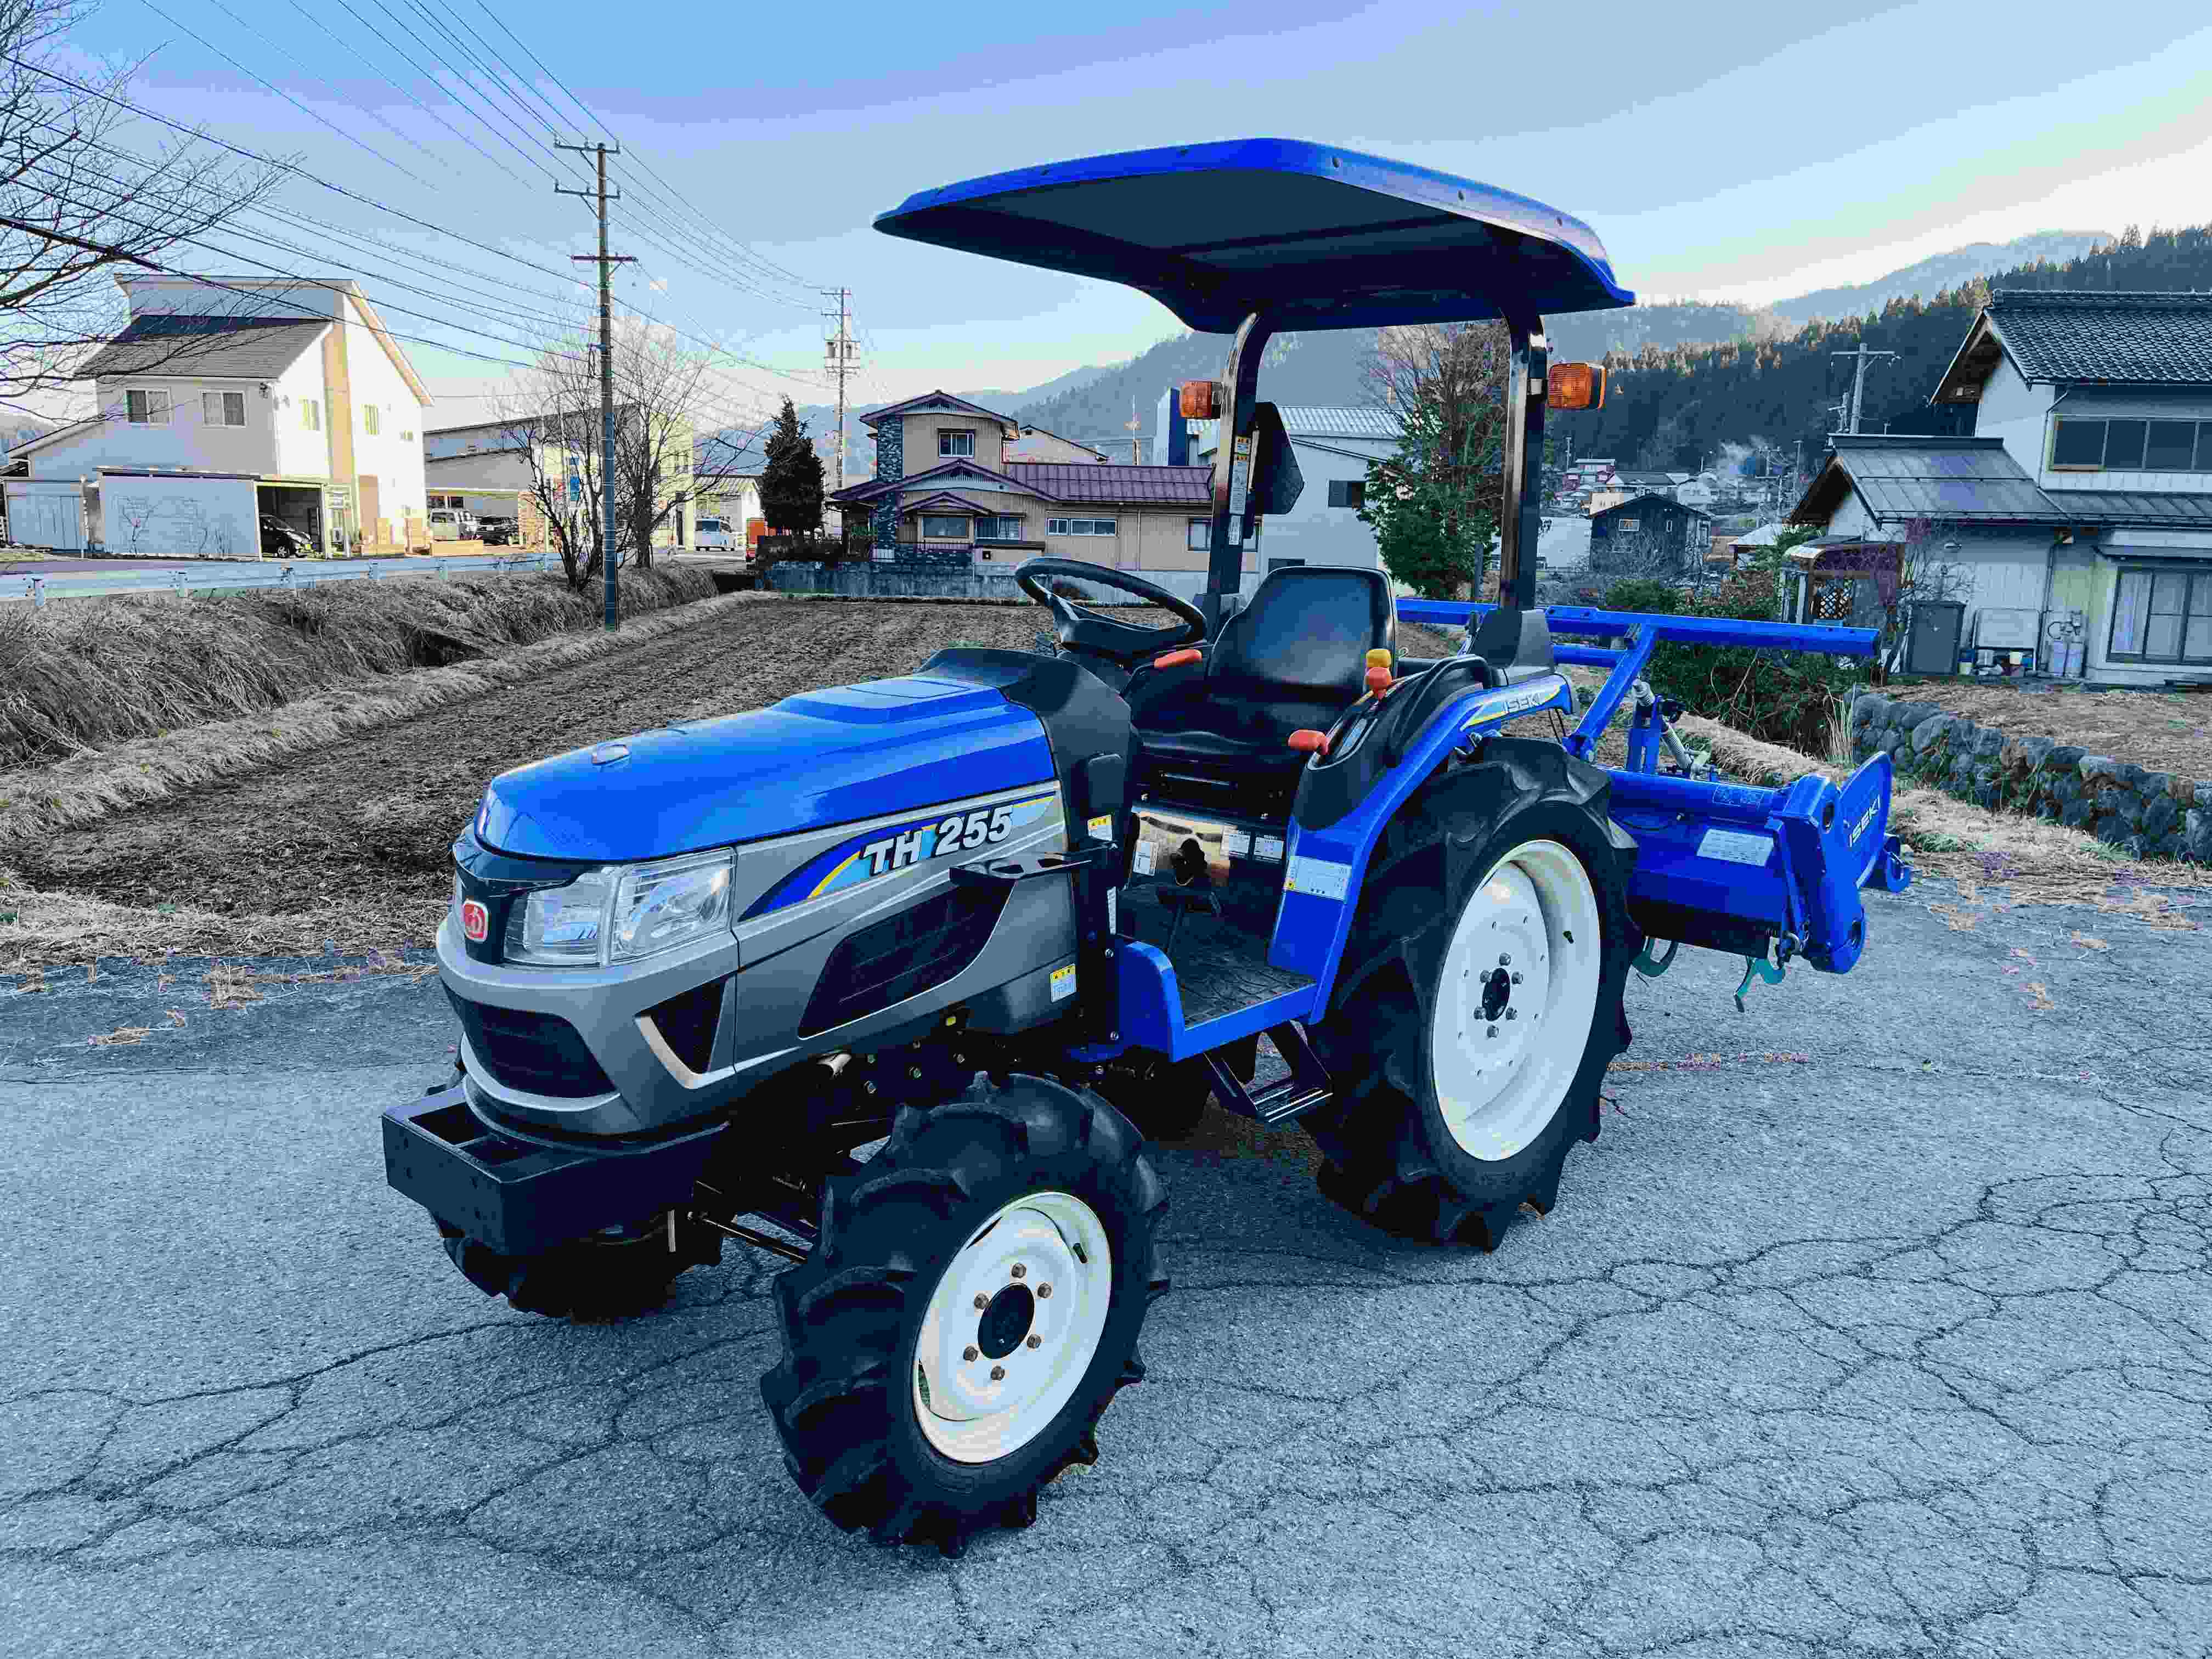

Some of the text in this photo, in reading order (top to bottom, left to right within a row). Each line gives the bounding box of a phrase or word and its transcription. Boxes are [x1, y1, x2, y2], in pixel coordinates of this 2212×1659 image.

[1503, 692, 1542, 714] ISEKI
[861, 806, 1013, 875] TH 255
[1849, 794, 1881, 847] ISEKI
